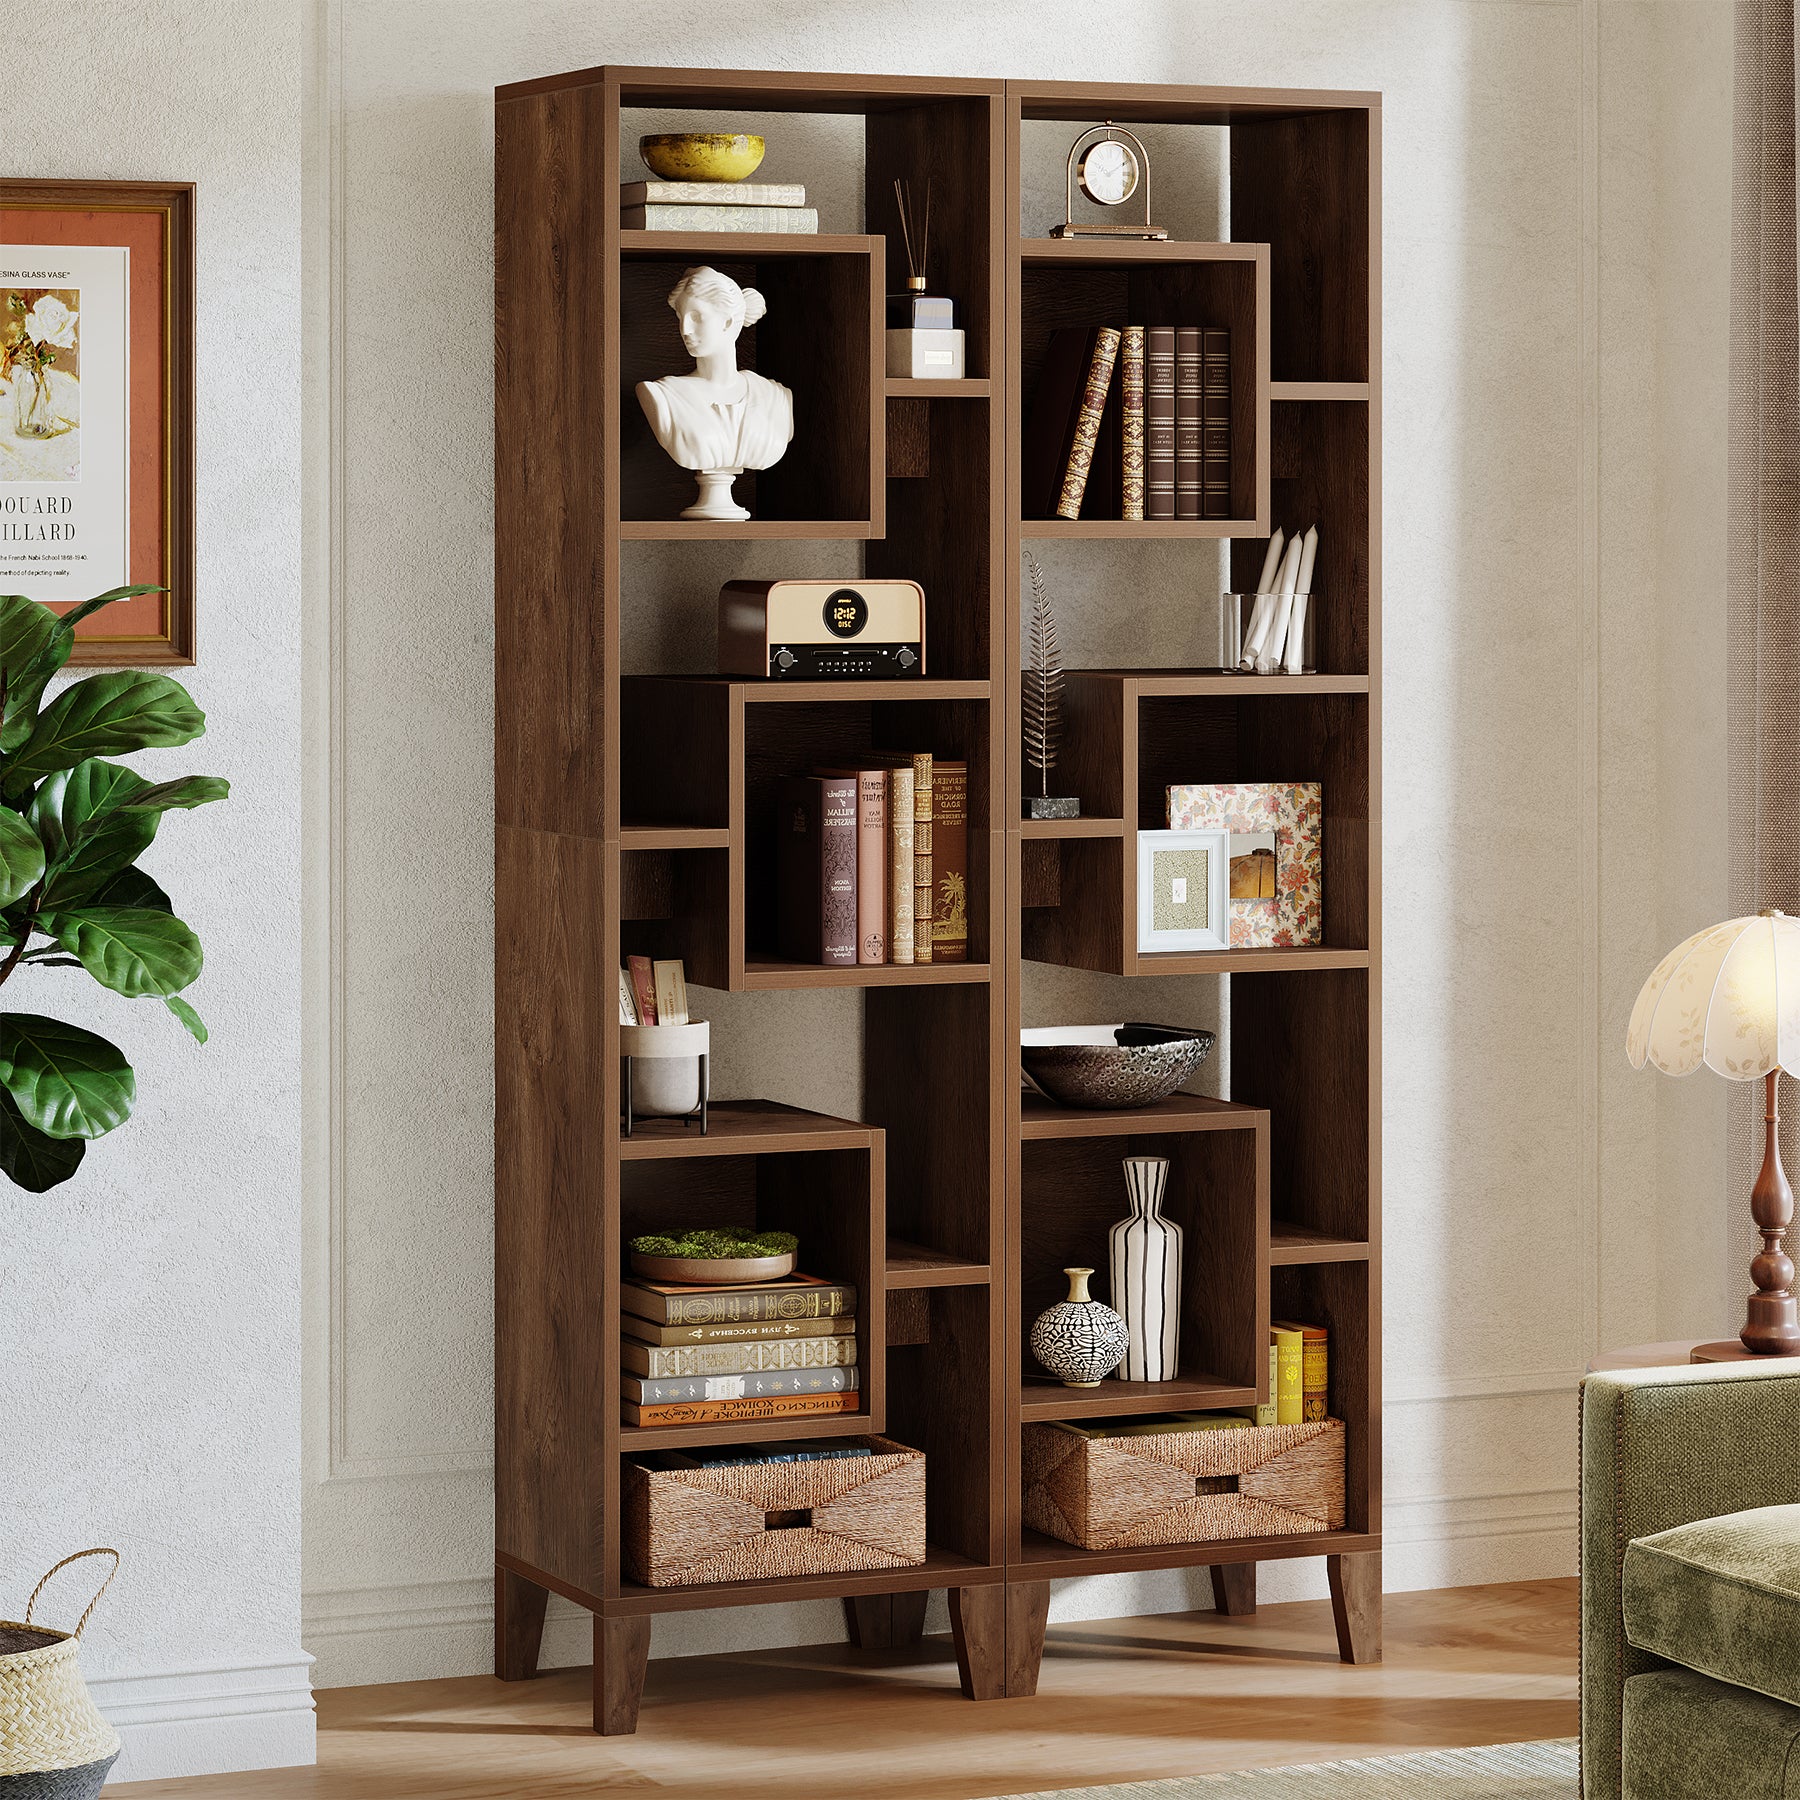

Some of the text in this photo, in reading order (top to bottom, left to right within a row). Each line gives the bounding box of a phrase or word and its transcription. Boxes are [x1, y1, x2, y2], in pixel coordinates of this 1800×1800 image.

[0, 497, 72, 514] OUARD
[3, 524, 76, 540] ILLARD
[28, 569, 52, 577] depicting
[834, 607, 856, 620] 12:12
[720, 1400, 775, 1411] ХОЛМСЕ
[789, 1399, 849, 1411] ЗАПИСКИ
[713, 1408, 774, 1420] ШЕРЛОКЕ
